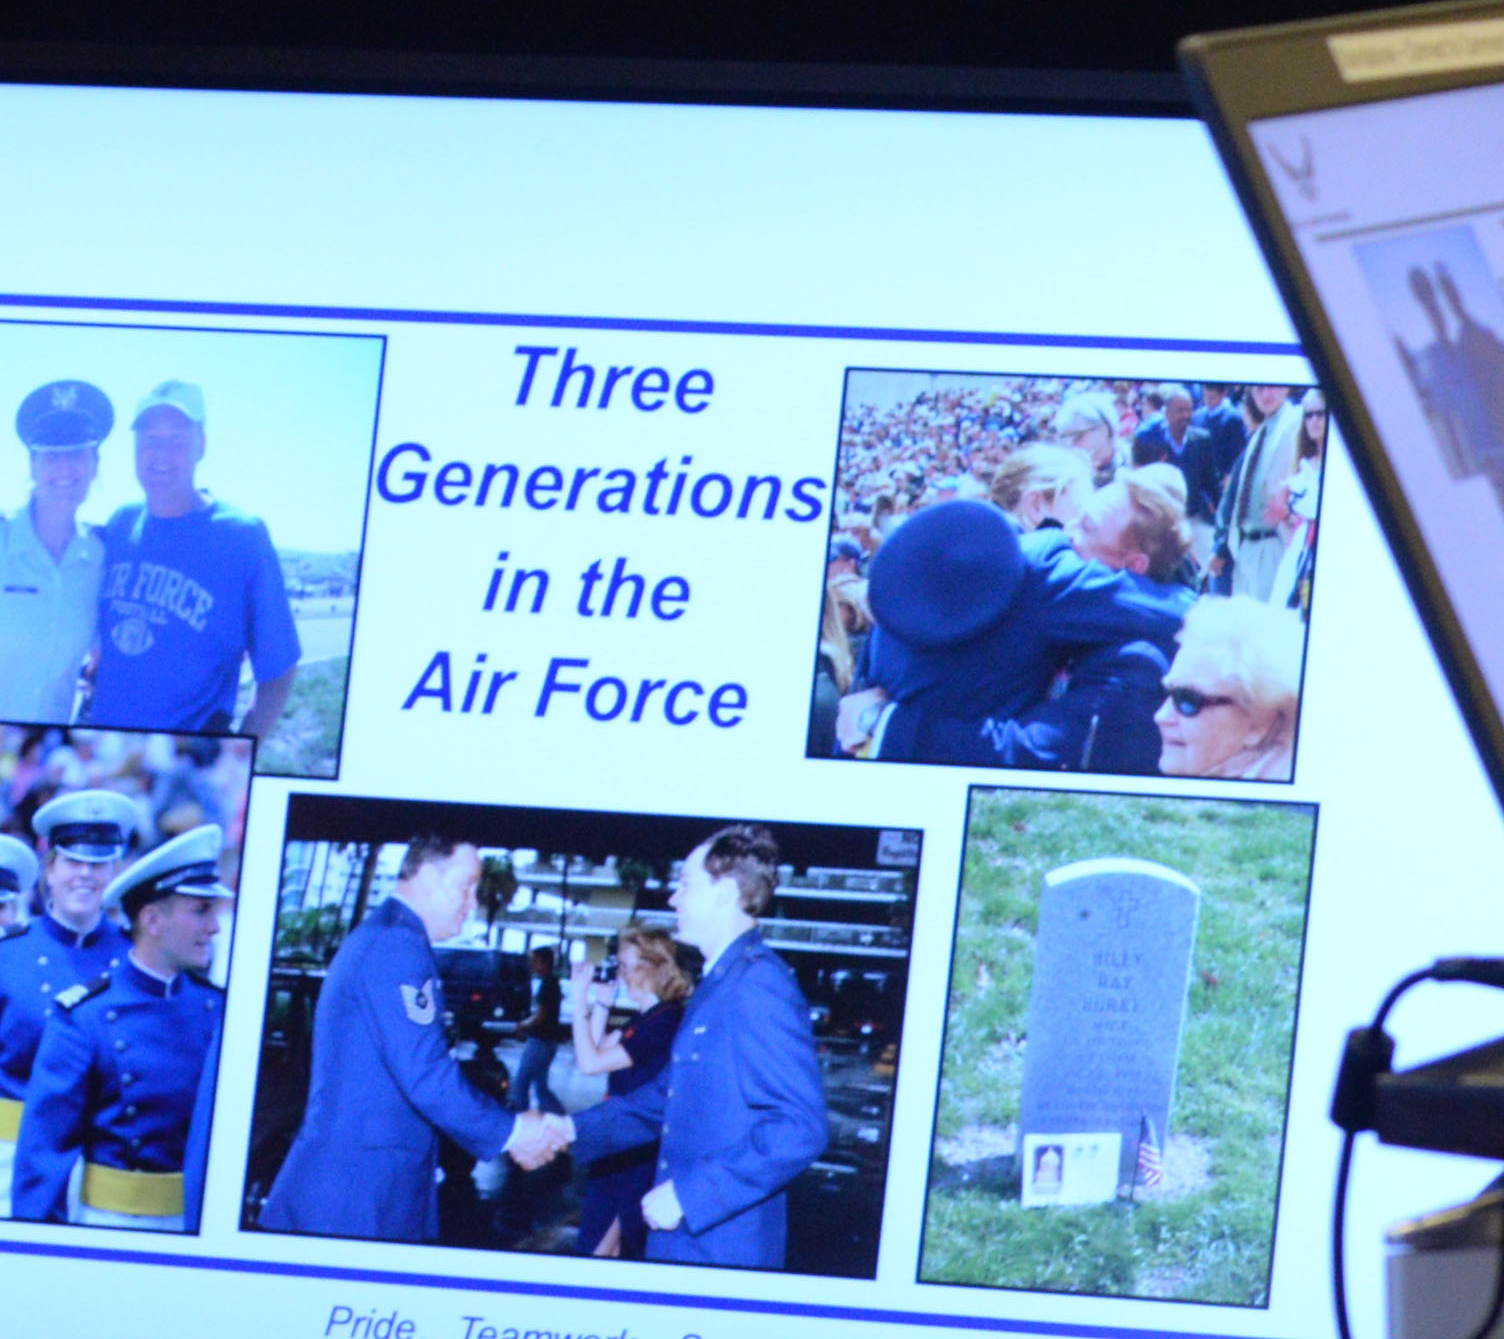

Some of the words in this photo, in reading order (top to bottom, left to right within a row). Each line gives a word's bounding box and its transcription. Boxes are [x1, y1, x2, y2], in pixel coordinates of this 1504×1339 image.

[514, 344, 715, 415] Three
[376, 441, 827, 523] Generations
[133, 561, 214, 633] FORCE
[482, 550, 550, 615] in
[576, 557, 691, 622] the
[400, 650, 519, 715] Air
[534, 656, 749, 729] Force
